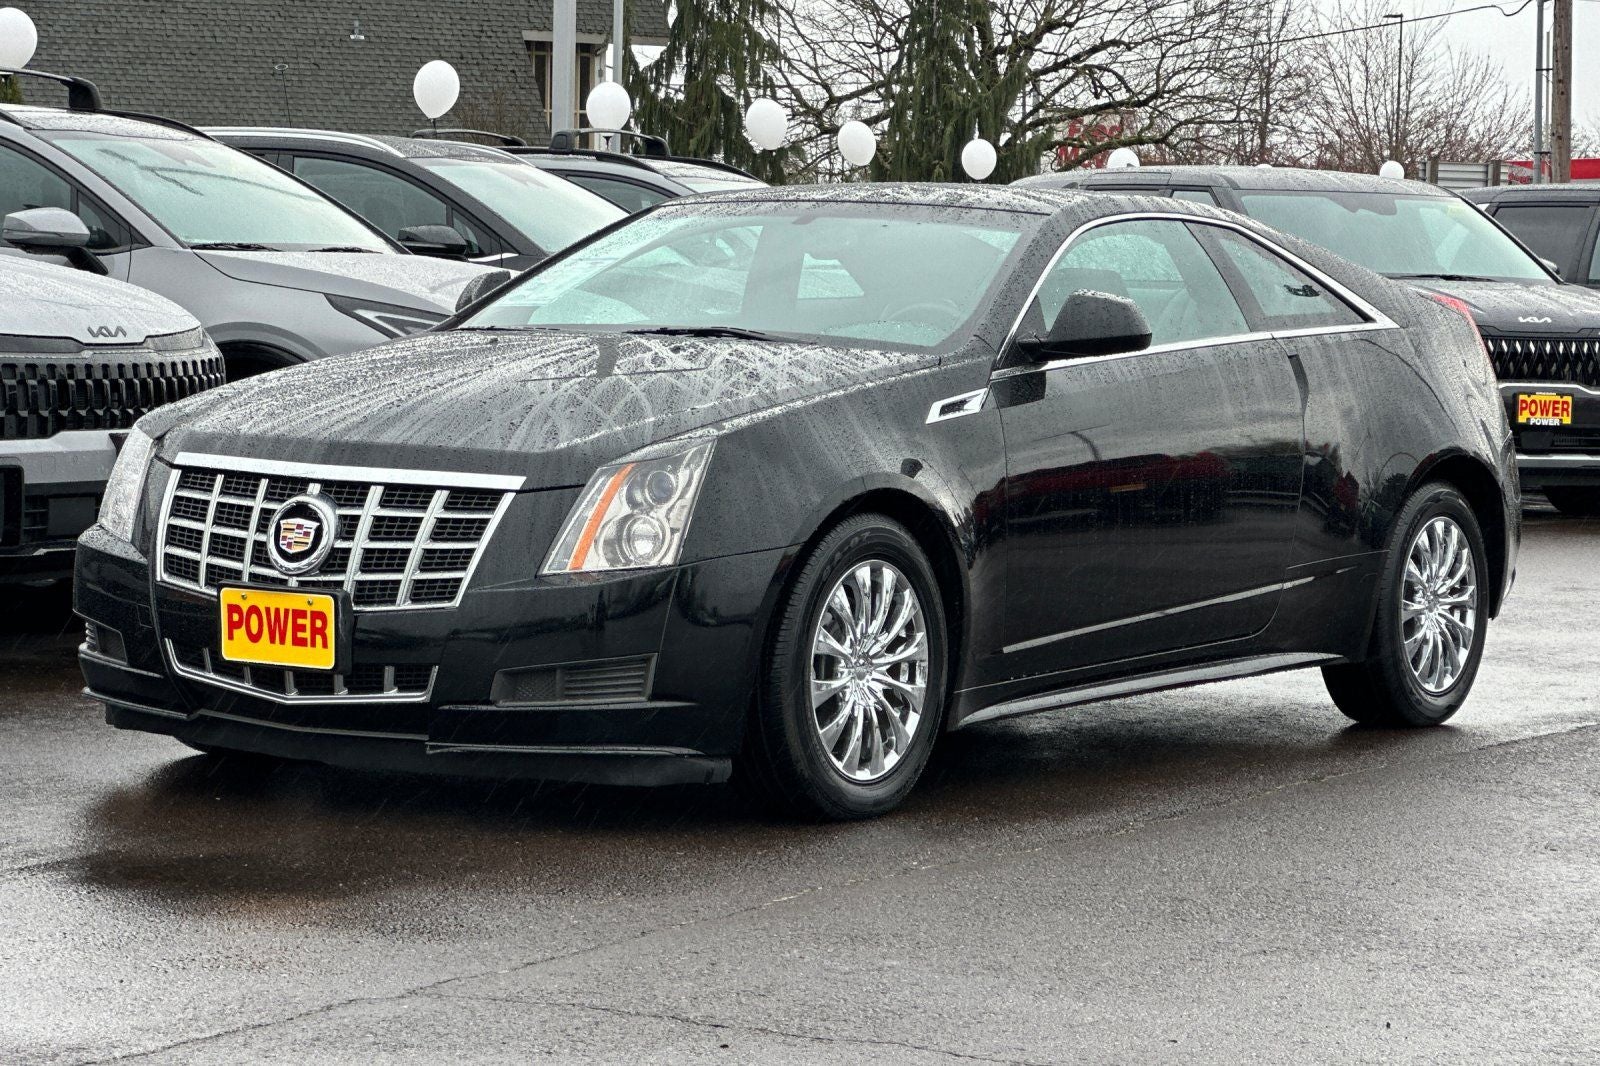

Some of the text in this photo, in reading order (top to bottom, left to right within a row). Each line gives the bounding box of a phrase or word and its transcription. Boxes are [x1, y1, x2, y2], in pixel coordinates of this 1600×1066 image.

[1520, 399, 1571, 417] POWER
[1530, 418, 1561, 426] POWER
[227, 603, 329, 650] POWER
